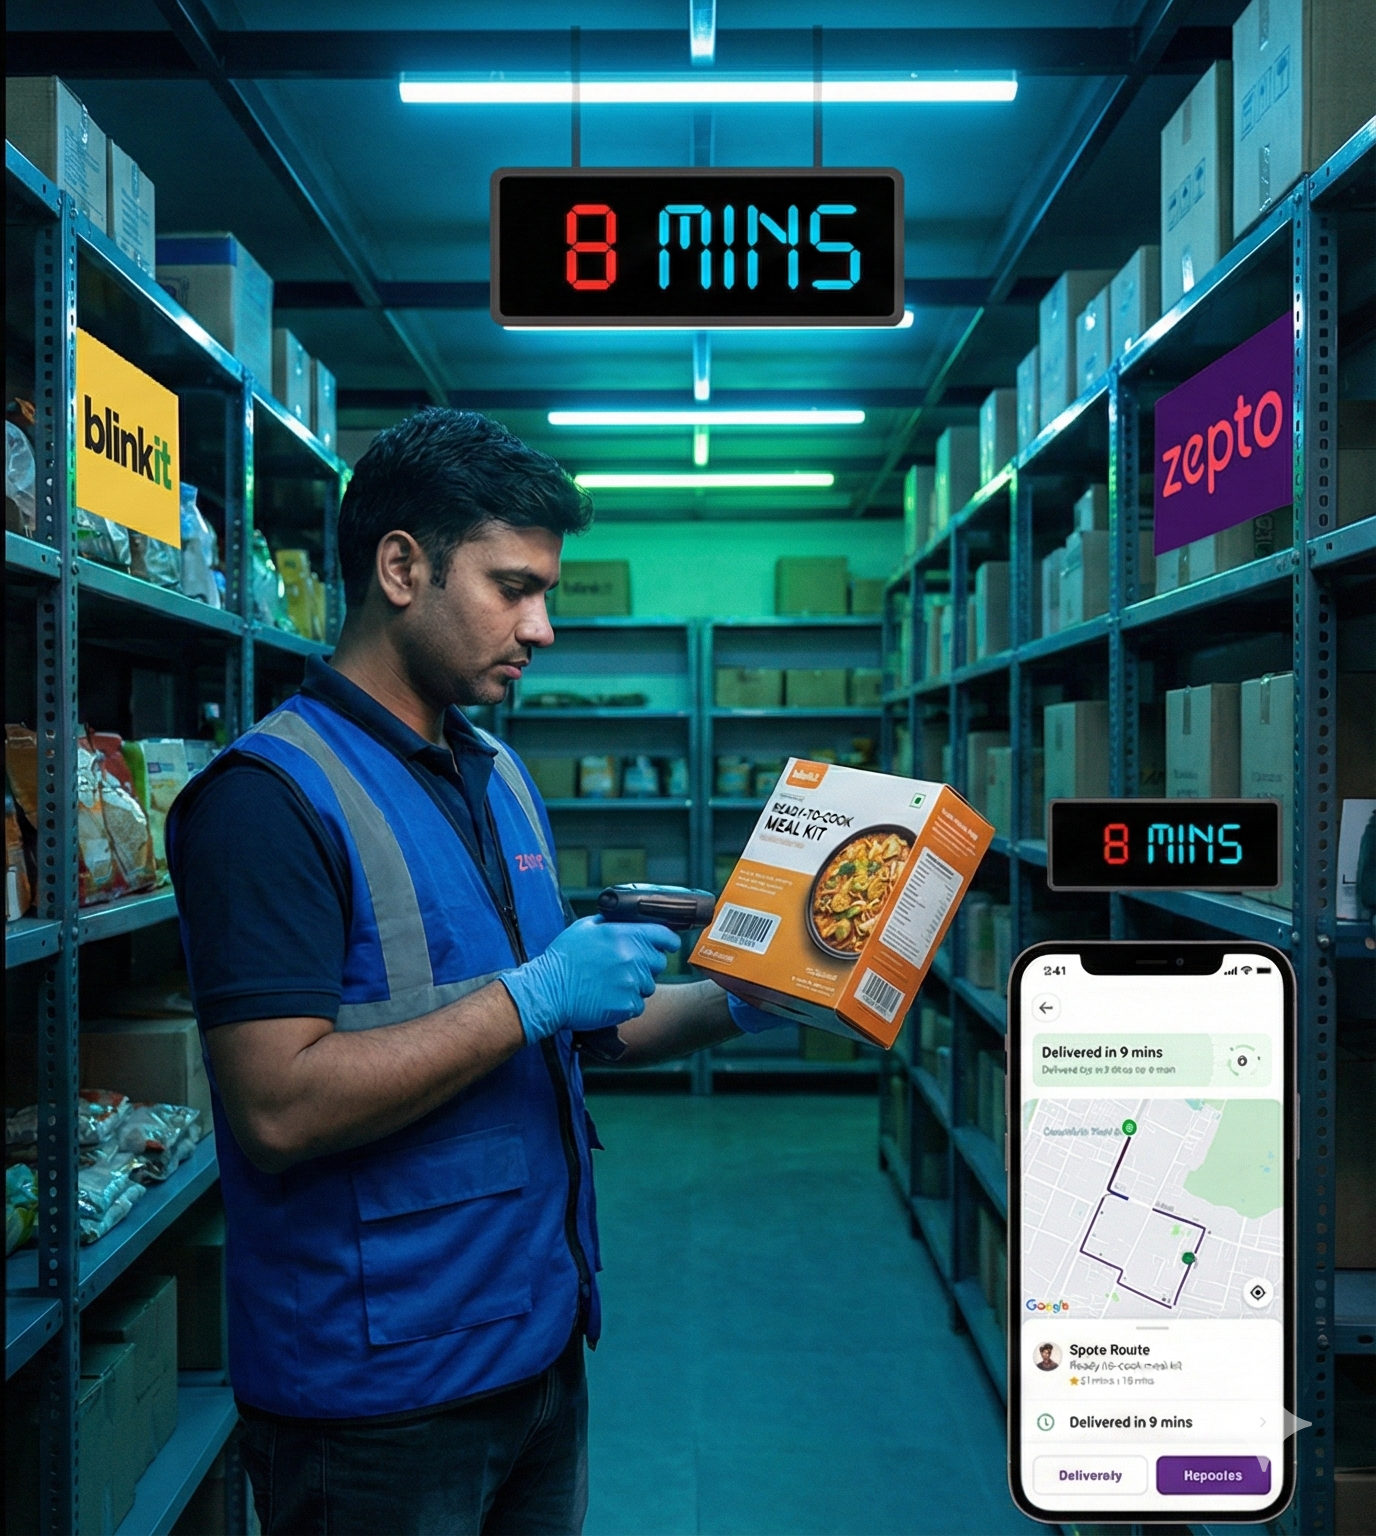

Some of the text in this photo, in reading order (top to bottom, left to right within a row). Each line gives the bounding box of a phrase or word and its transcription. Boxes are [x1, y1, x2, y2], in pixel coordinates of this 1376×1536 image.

[566, 204, 861, 290] 8 MINS
[84, 394, 172, 490] blinkit
[1162, 390, 1283, 498] zepto
[765, 815, 827, 841] MEAL KIT
[1104, 823, 1243, 864] 8 MINS
[1042, 1046, 1163, 1058] Delivered in 9 mins
[1069, 1344, 1107, 1358] Spote
[1069, 1416, 1193, 1428] Delivered in 9 mins
